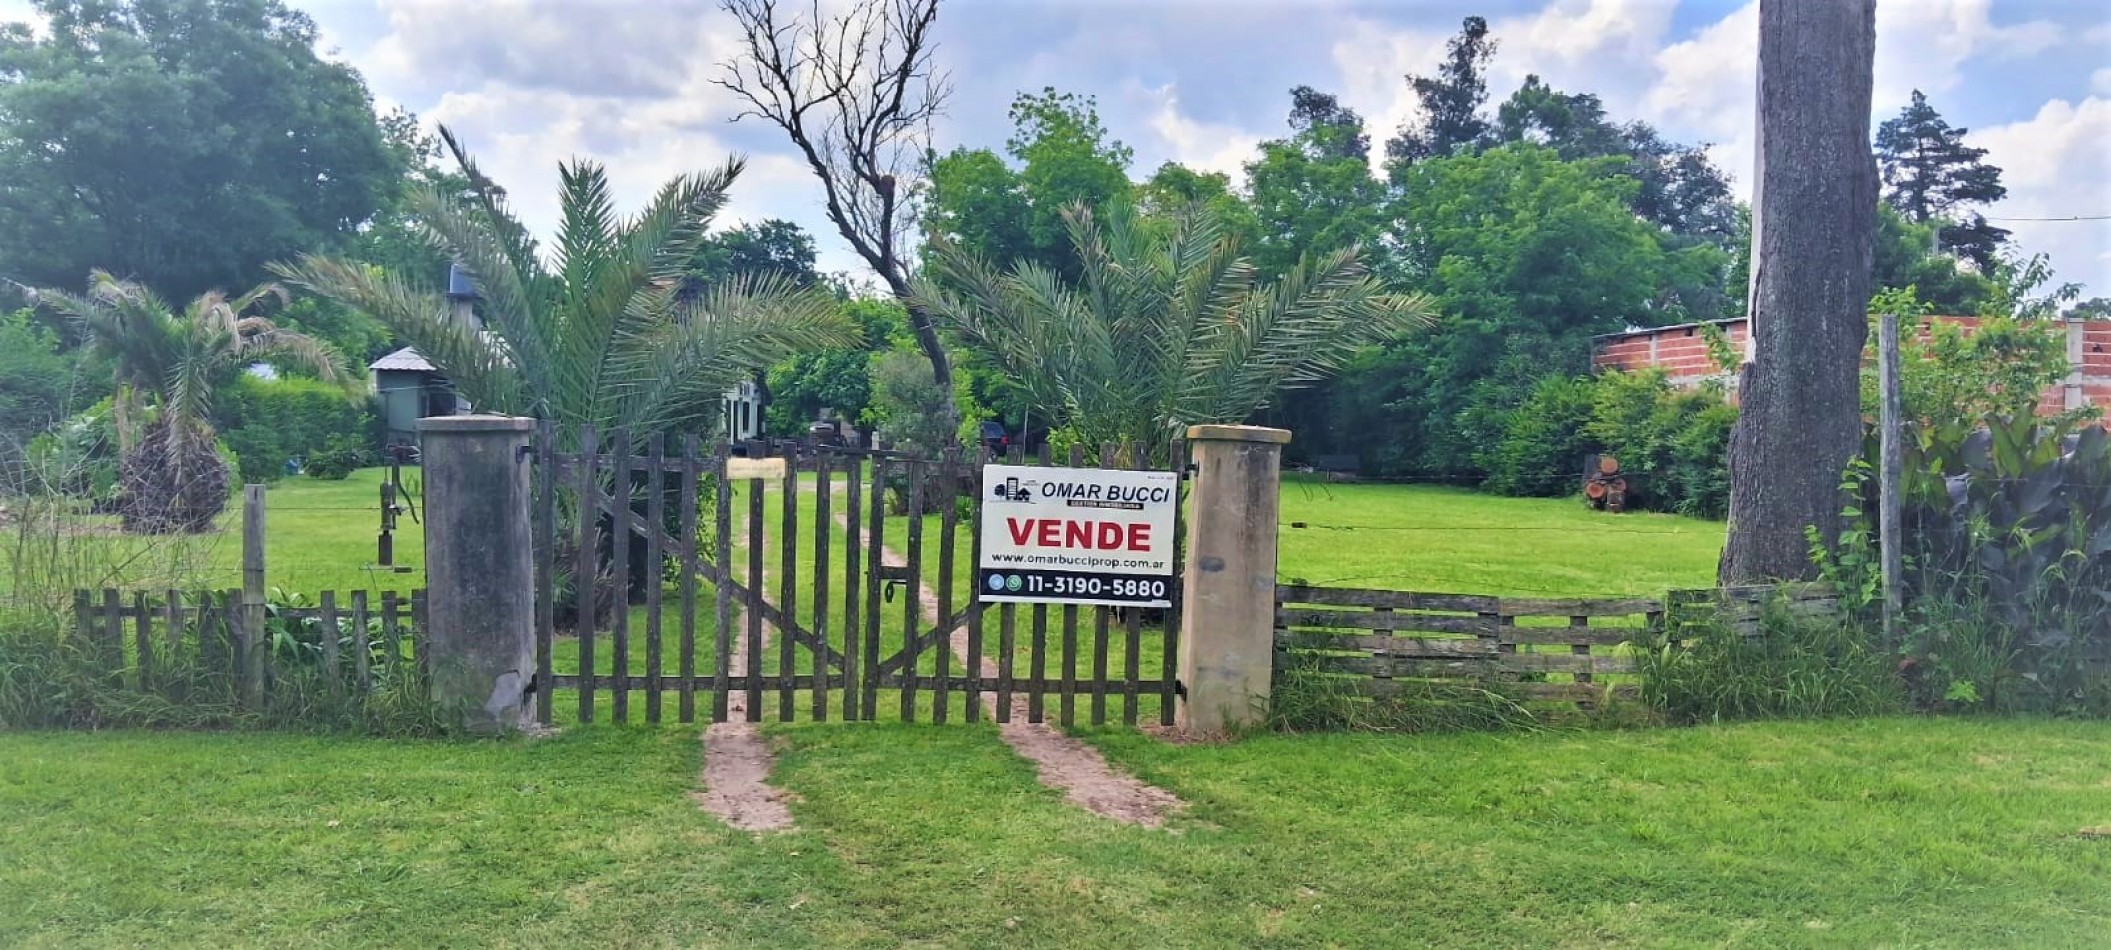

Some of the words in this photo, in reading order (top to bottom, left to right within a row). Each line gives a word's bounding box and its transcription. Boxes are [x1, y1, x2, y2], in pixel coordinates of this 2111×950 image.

[1041, 482, 1100, 500] OMAR
[1107, 486, 1170, 503] BUCCI
[1007, 517, 1152, 552] VENDE
[991, 553, 1165, 569] www.omarbucciprop.com.ar
[1027, 575, 1165, 597] 11-3190-5880
